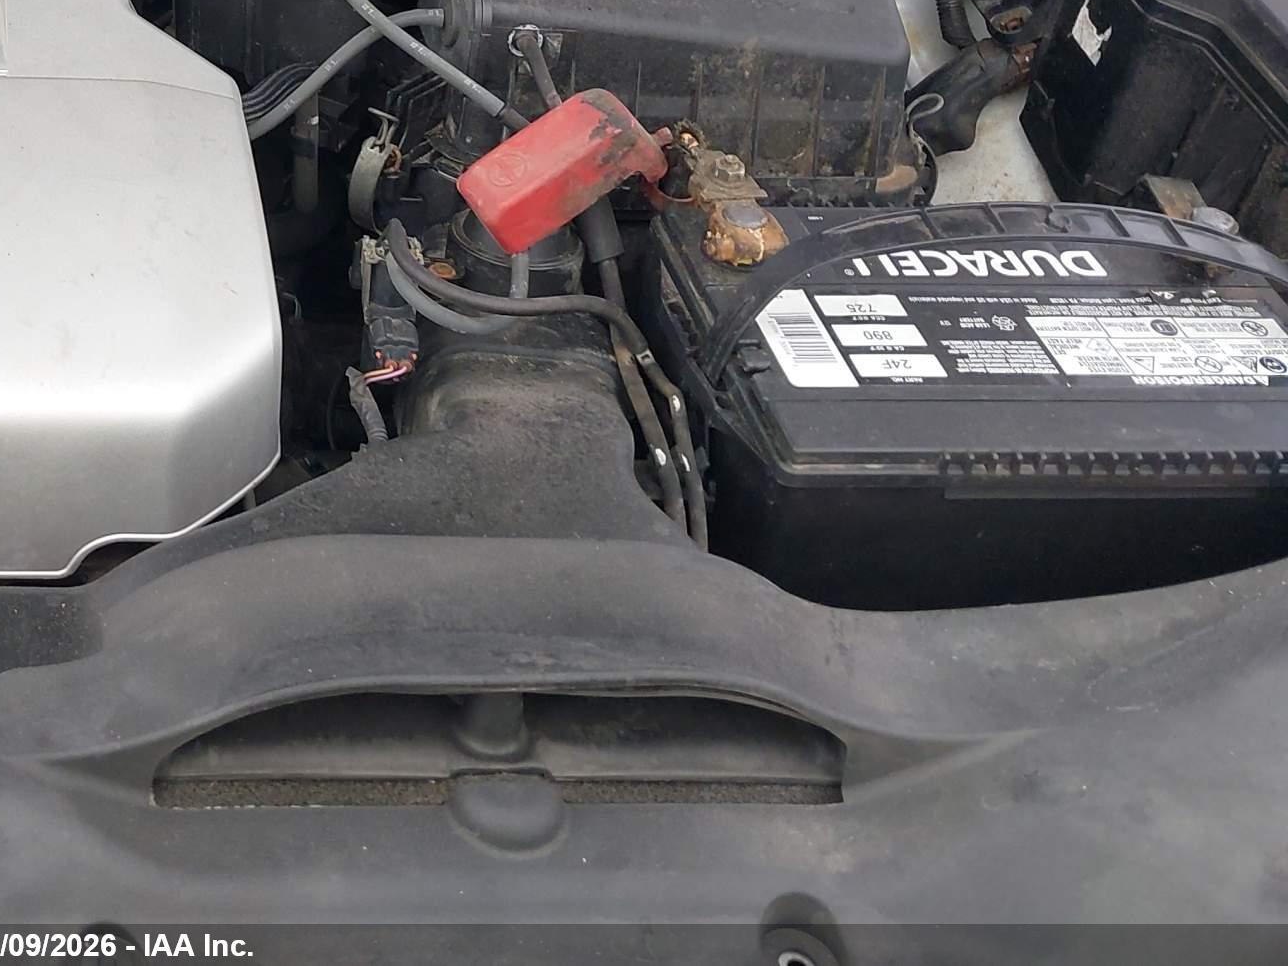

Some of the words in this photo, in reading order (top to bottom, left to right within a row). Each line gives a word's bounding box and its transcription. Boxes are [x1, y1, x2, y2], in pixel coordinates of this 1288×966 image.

[846, 303, 878, 314] 725
[863, 330, 894, 341] 890
[882, 359, 913, 370] 24F
[1131, 375, 1257, 386] DANGER/POISON
